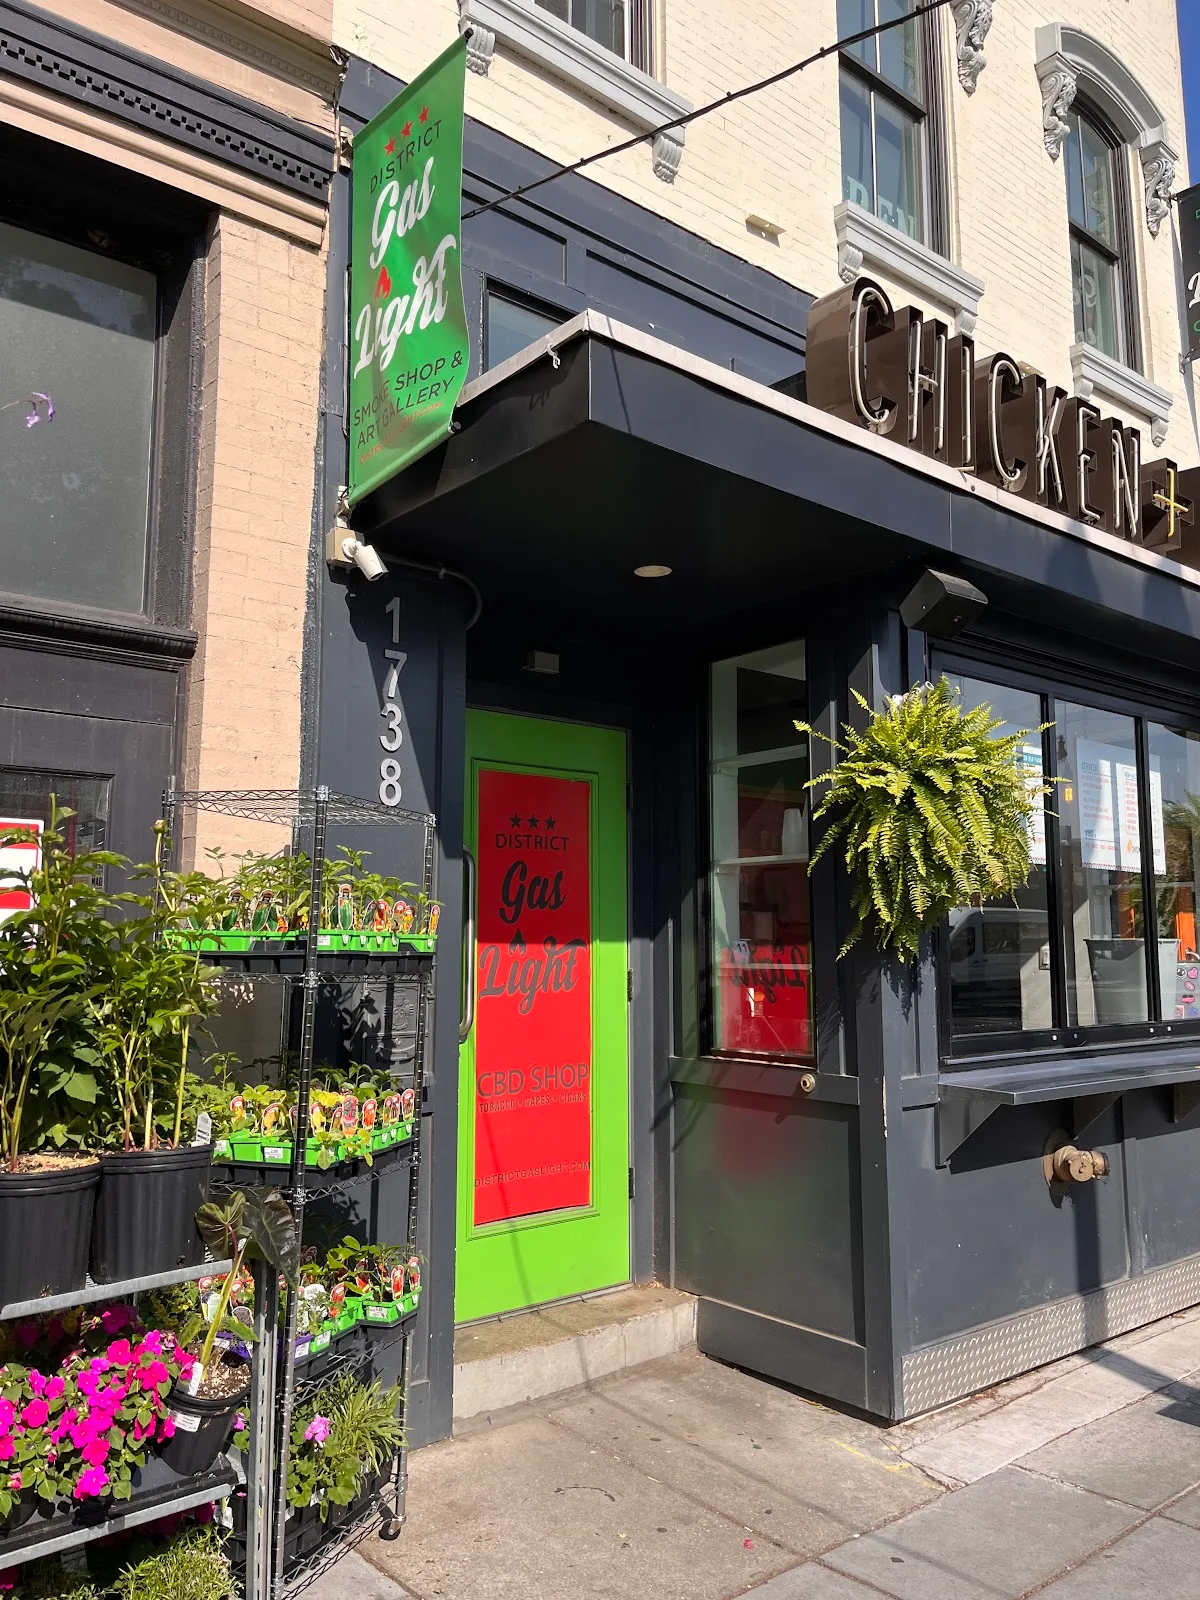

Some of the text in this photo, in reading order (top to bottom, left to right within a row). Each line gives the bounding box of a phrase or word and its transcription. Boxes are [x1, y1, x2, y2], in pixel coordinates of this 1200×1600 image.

[370, 119, 442, 195] DISTRICT
[369, 156, 435, 270] Gas
[353, 234, 457, 380] Light
[382, 375, 455, 428] GALLERY
[394, 357, 446, 391] SHOP
[450, 350, 463, 369] &
[847, 276, 1144, 548] CHICKEN
[379, 596, 408, 807] 1738
[495, 833, 570, 852] DISTRICT
[498, 860, 567, 925] Gas
[477, 935, 587, 1016] Light
[477, 1063, 589, 1098] CBD SHOP
[479, 1091, 587, 1114] TOBACCO VAPES CIGARS
[474, 1160, 591, 1189] DISTRICTGASLIGHT.COM
